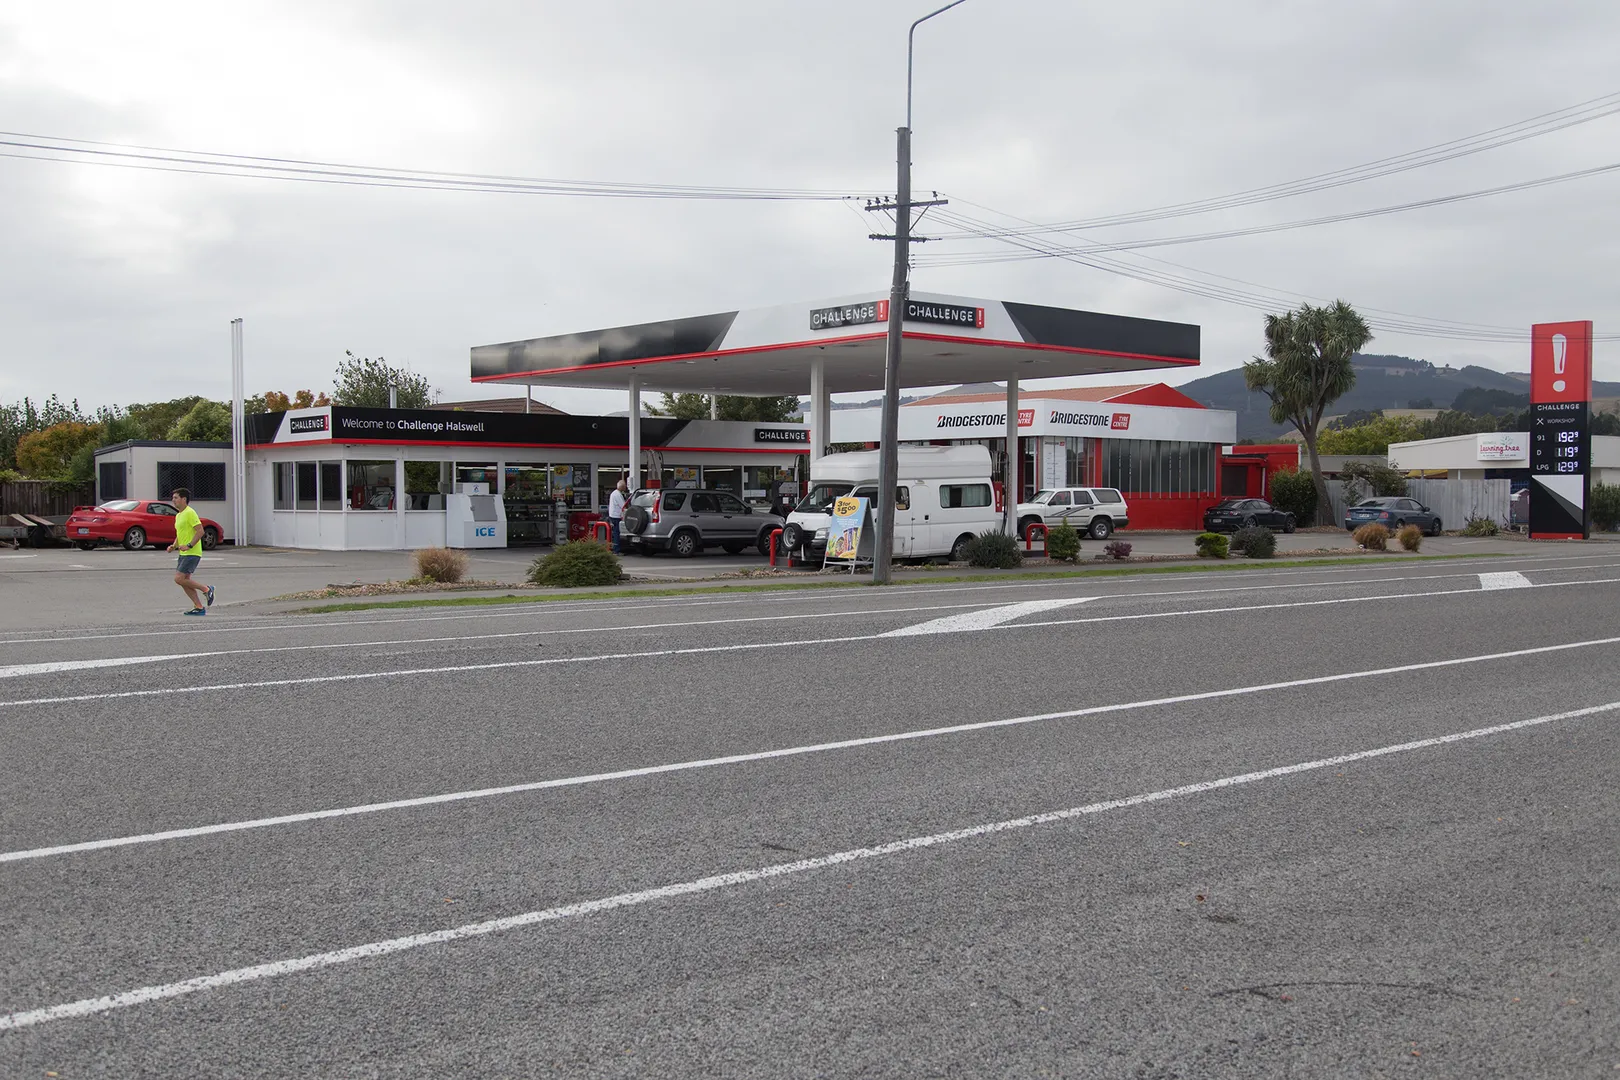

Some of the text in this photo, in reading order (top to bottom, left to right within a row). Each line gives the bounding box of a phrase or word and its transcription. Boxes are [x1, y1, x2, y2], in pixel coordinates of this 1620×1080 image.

[812, 305, 875, 325] CHALLENGE
[908, 304, 974, 322] CHALLENGE
[1537, 403, 1580, 411] CHALLENGE
[291, 418, 324, 430] CHALLENGE
[342, 418, 484, 432] Welcome to Challenge Halswell
[937, 413, 1006, 428] BRIDGESTONE
[1050, 411, 1109, 426] BRIDGESTONE
[759, 431, 806, 440] CHALLENGE
[475, 527, 496, 537] ICE
